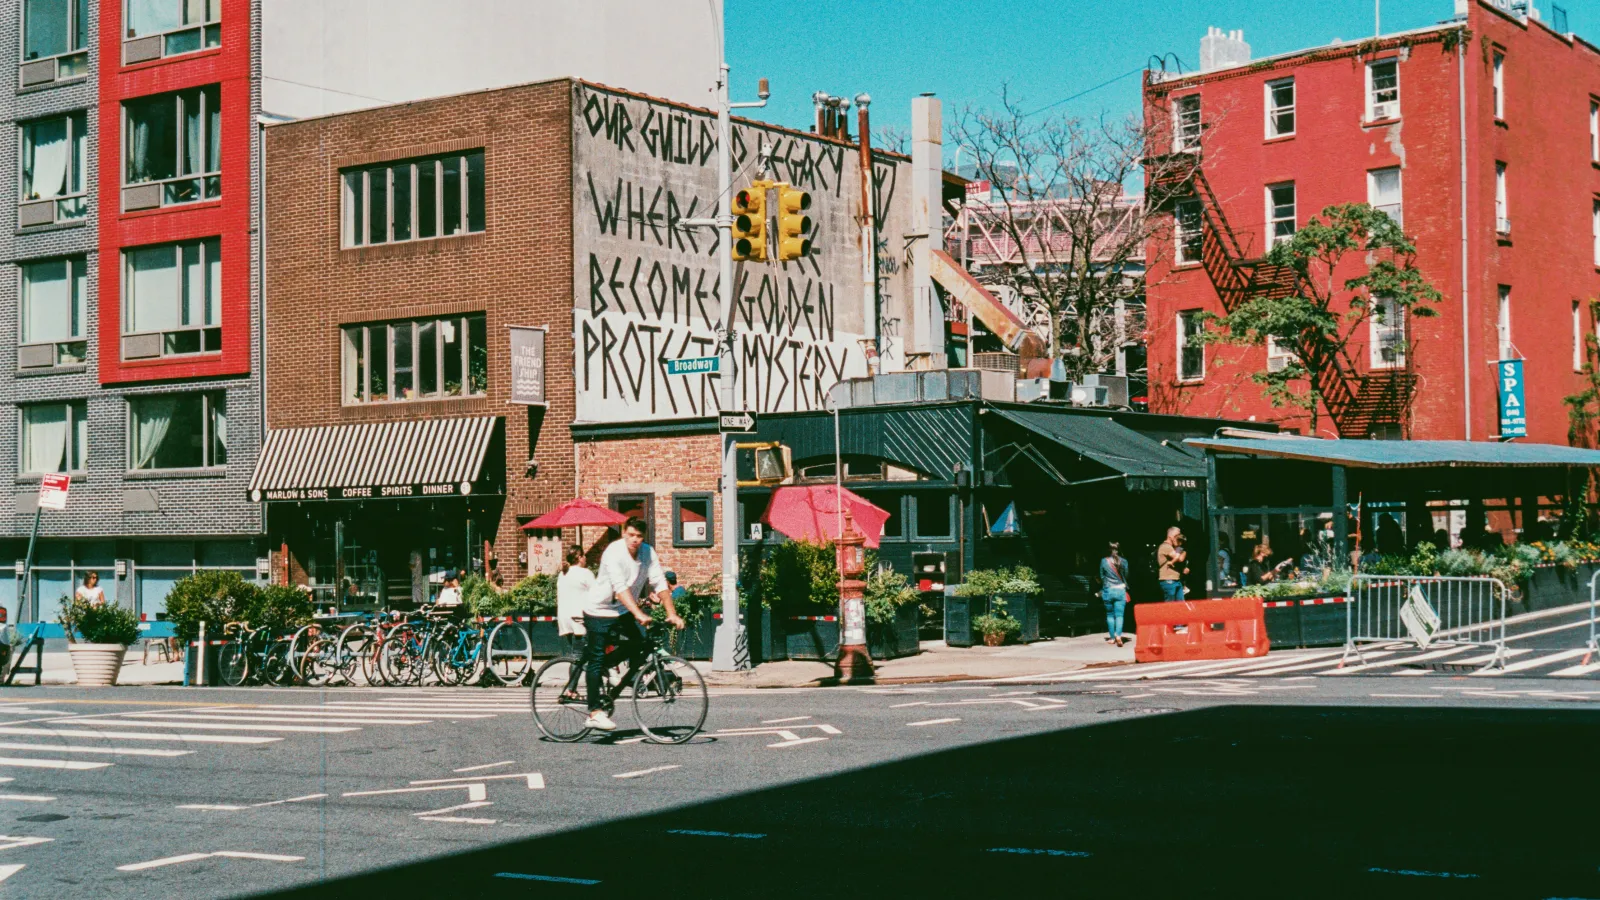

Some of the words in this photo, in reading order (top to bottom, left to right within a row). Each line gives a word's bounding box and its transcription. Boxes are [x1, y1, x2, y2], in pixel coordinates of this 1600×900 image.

[583, 93, 635, 153] OUR
[640, 108, 747, 172] GUILDD
[738, 270, 834, 342] GOLDEN
[521, 345, 535, 356] THE
[514, 355, 541, 368] FRIEND
[674, 359, 713, 371] Broadway
[519, 367, 537, 379] SHIP
[1504, 363, 1520, 407] SPA
[723, 417, 734, 426] ONE
[739, 417, 751, 426] WAY
[266, 490, 299, 499] MARLOW
[300, 490, 305, 498] &
[307, 489, 328, 498] SONS
[342, 487, 371, 497] COFFEE
[381, 486, 412, 496] SPIRITS
[422, 484, 453, 494] DINNER
